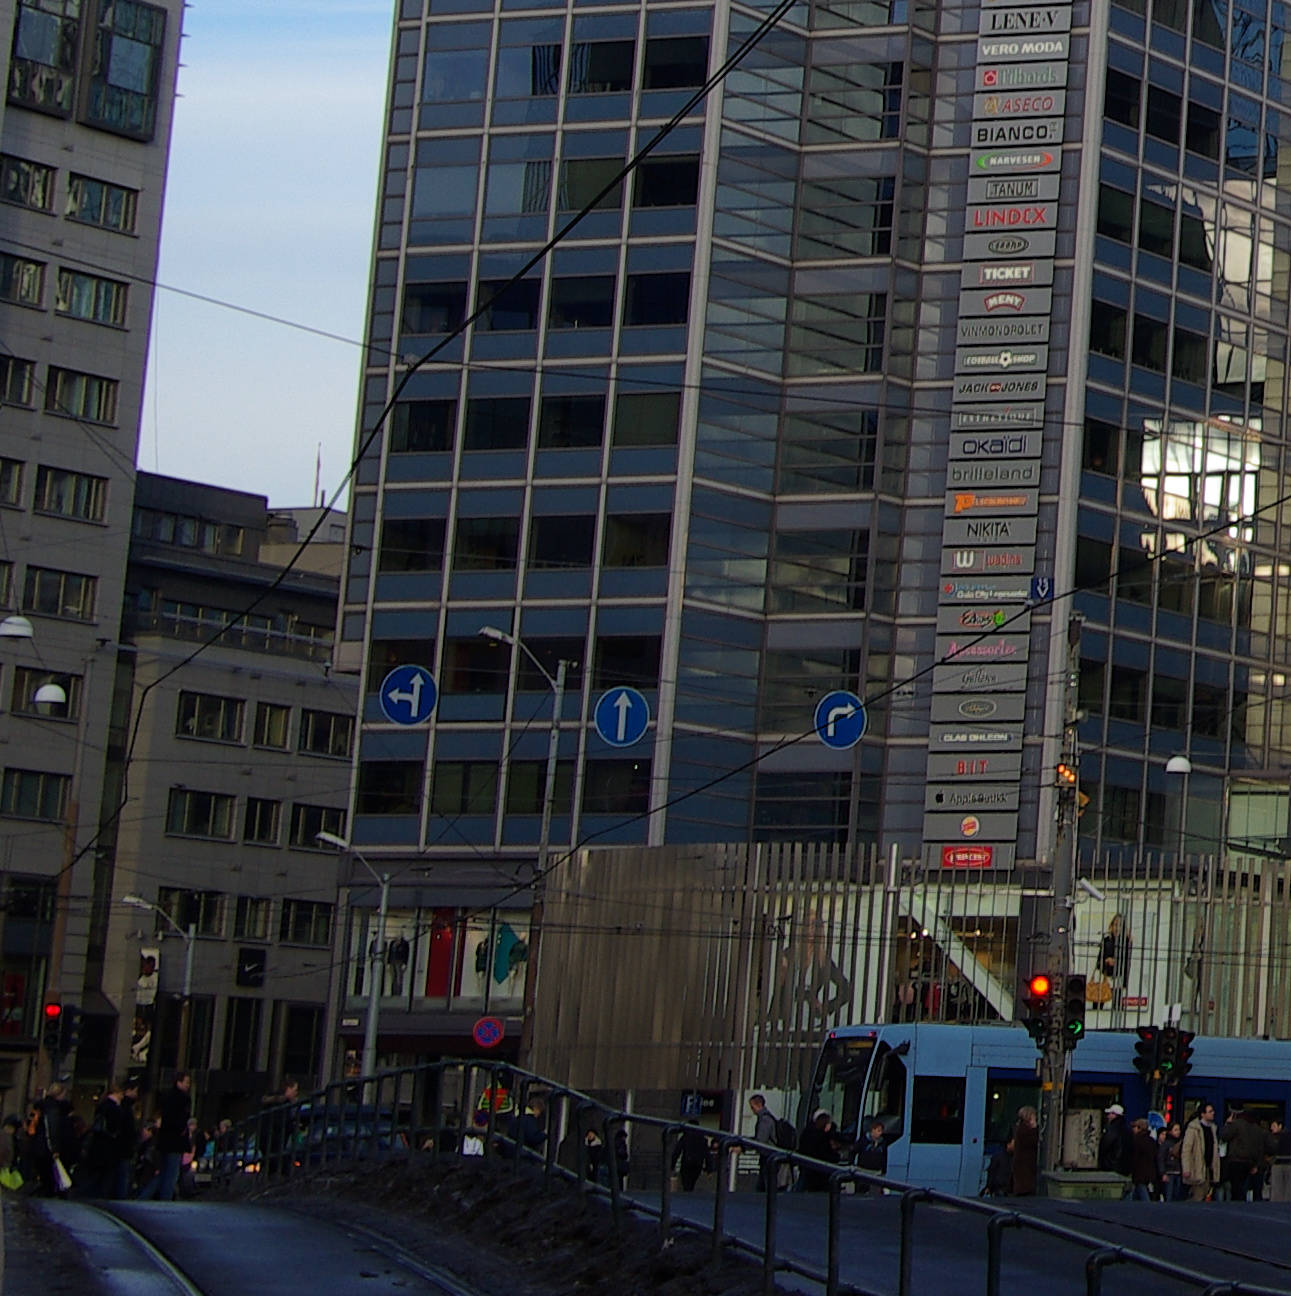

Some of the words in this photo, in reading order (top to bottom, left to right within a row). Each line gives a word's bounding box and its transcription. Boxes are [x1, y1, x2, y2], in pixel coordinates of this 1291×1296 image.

[982, 44, 1019, 56] VERO
[1021, 41, 1063, 54] MODA
[1002, 96, 1054, 113] ASECO
[989, 155, 1041, 166] NARVESEN
[993, 182, 1033, 197] TANUM
[974, 207, 1048, 227] LINDEX
[984, 266, 1031, 280] TICKET
[987, 294, 1022, 308] MENY
[961, 324, 1044, 338] VINMONOPOLET
[959, 384, 989, 394] JACK
[1001, 381, 1039, 393] JONES
[952, 467, 1033, 482] brilleland
[966, 521, 1011, 537] NIKITA
